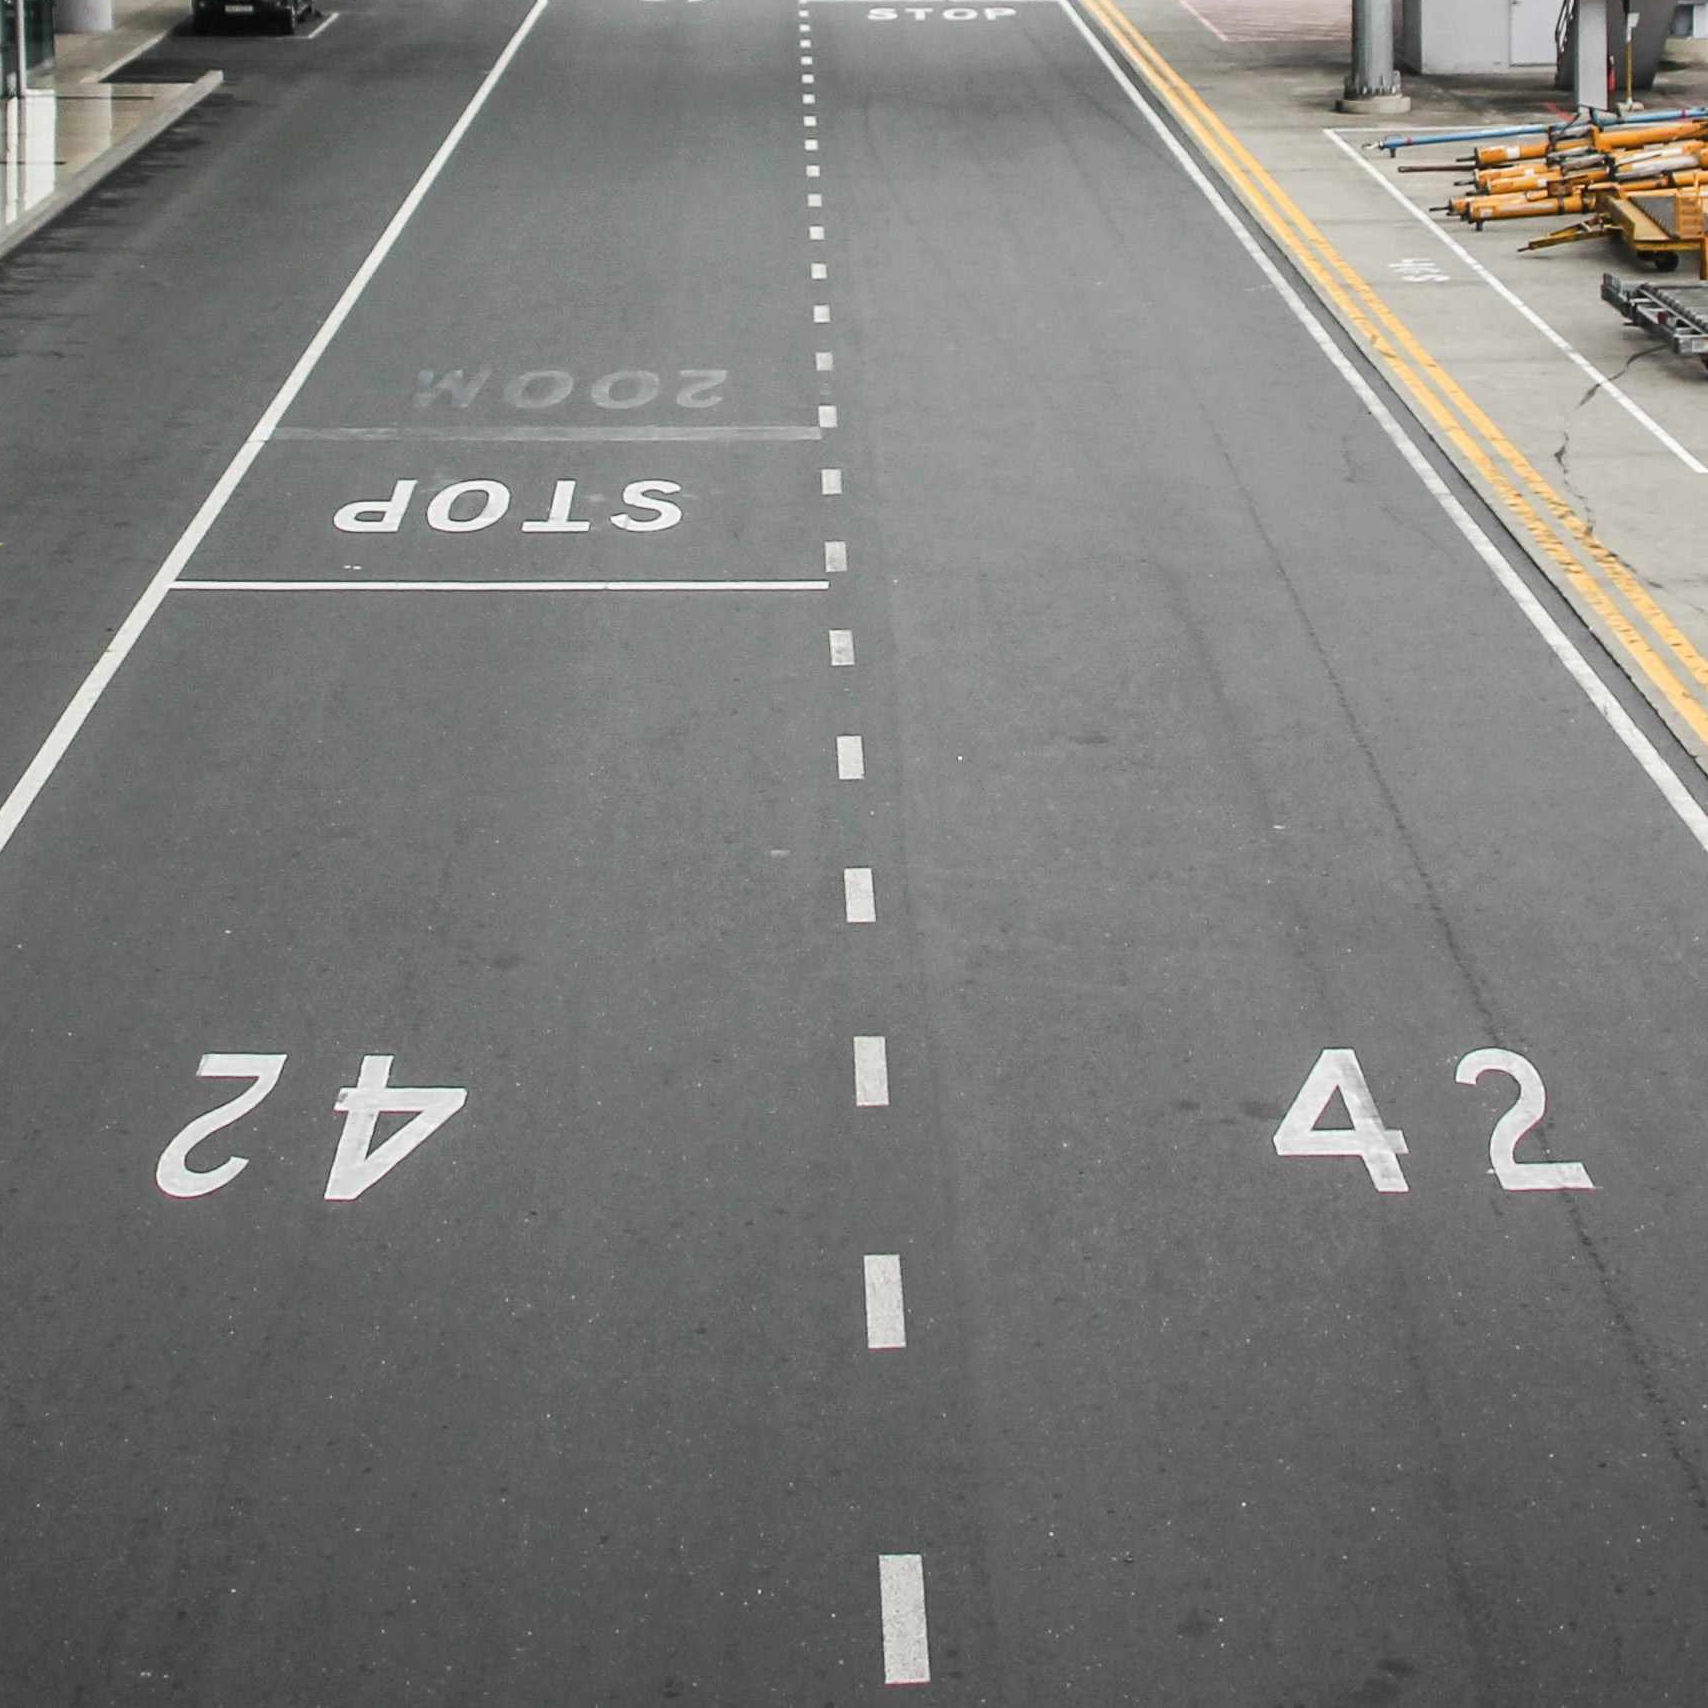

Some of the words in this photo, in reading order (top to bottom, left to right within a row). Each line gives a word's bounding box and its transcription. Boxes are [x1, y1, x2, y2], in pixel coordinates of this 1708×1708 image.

[867, 7, 1017, 21] STOP
[412, 368, 728, 411] 200M
[332, 478, 683, 533] STOP
[156, 1054, 468, 1200] 42
[1272, 1048, 1603, 1193] 42
